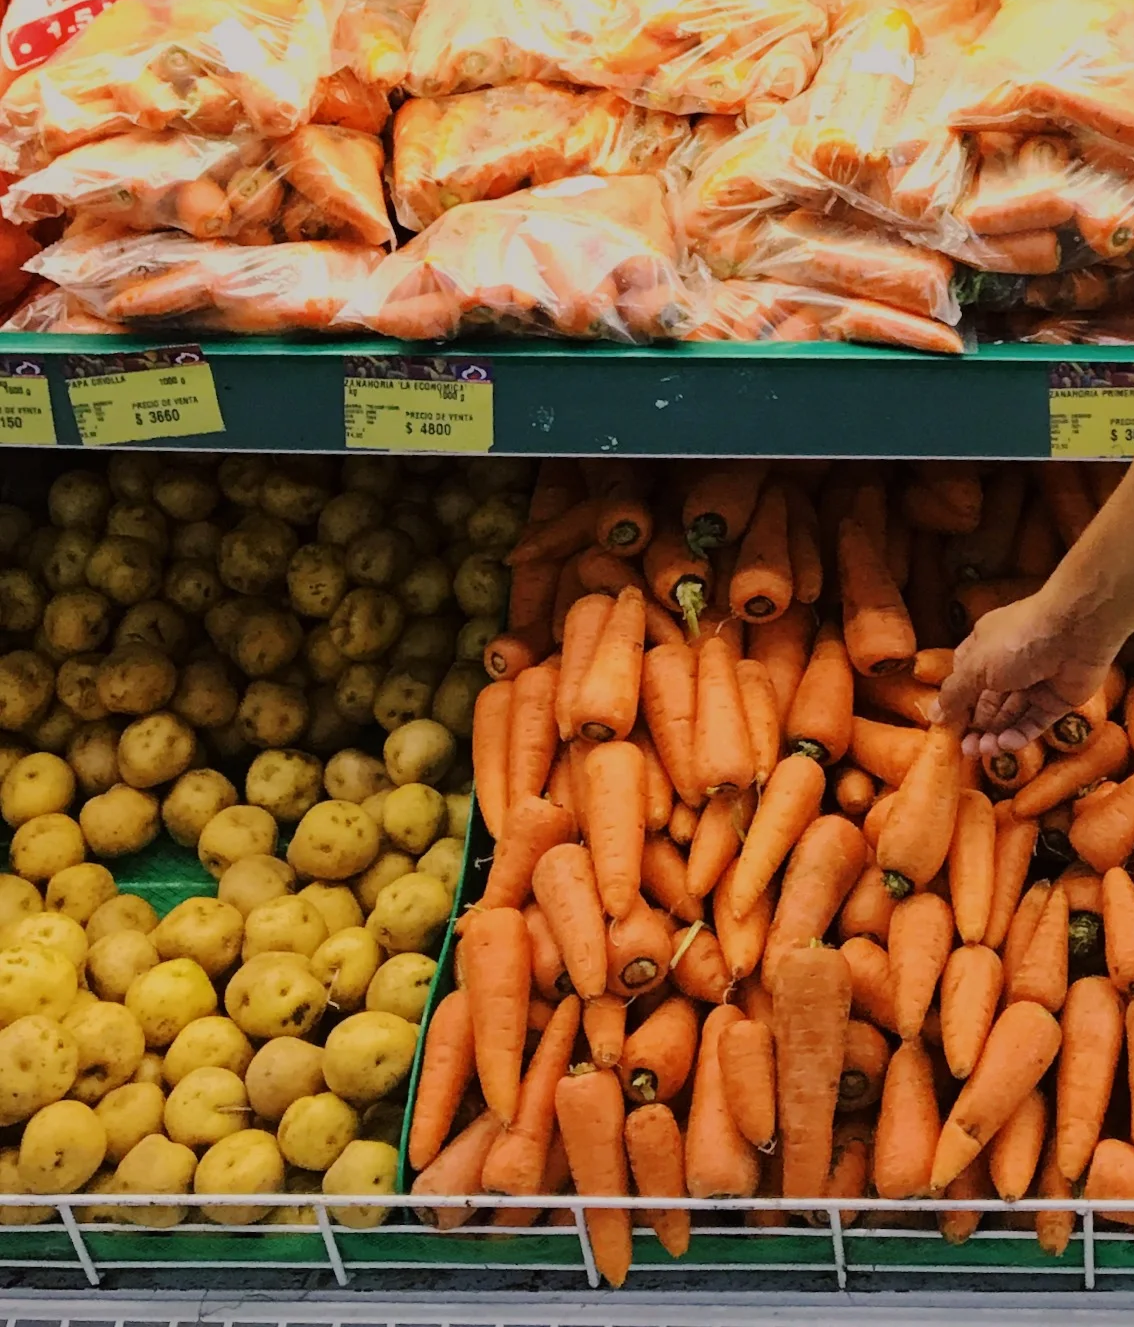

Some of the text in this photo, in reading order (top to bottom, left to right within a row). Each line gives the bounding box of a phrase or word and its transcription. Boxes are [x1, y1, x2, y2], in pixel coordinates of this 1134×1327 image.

[67, 380, 88, 389] APA
[344, 379, 394, 389] ZANAHORIA
[1049, 390, 1099, 398] ZANAHORIA
[132, 396, 199, 410] PRECIO DE VENTA
[18, 407, 42, 415] VENTA
[149, 409, 180, 424] 3660
[405, 411, 474, 422] PRECIO DE VENTA
[405, 422, 451, 435] $ 4800
[1110, 429, 1118, 442] $
